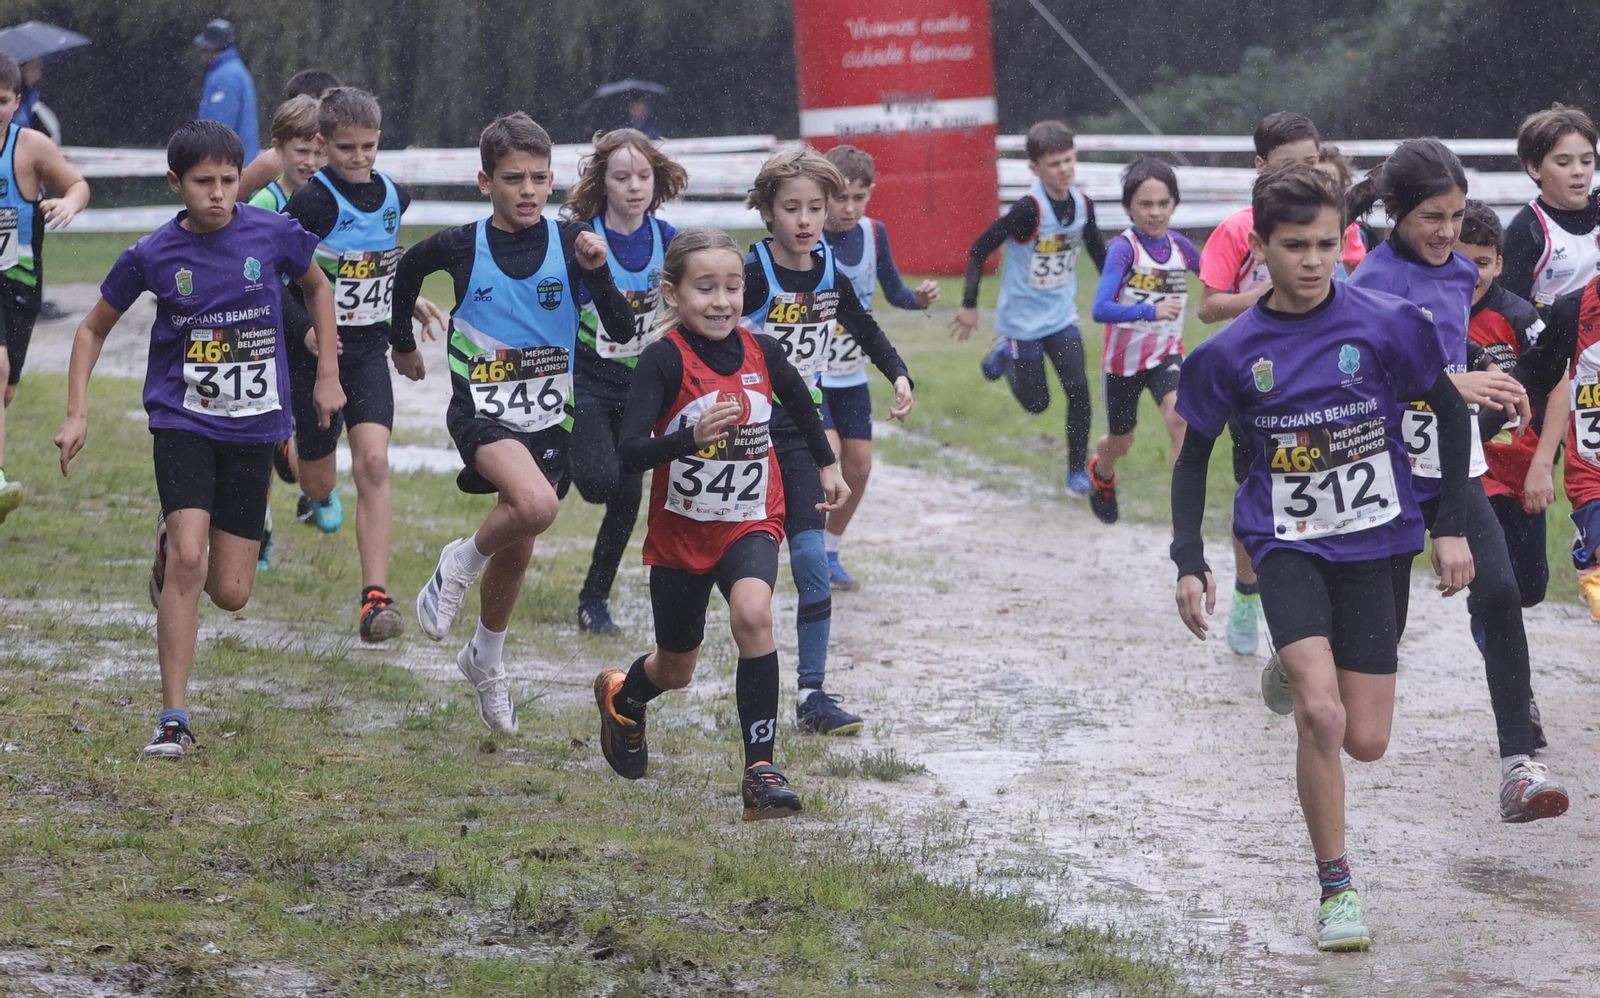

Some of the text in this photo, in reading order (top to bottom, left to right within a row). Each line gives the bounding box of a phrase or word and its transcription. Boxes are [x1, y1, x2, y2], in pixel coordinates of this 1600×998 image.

[187, 312, 224, 325] CHANS
[225, 305, 270, 322] BEMBRIVE
[237, 337, 276, 349] BELARMINO
[250, 346, 276, 357] ALONSO
[773, 323, 829, 360] 351
[521, 354, 568, 367] BELARMINO
[534, 362, 567, 374] ALONSO
[194, 362, 267, 401] 313
[475, 377, 563, 418] 346
[1255, 397, 1378, 429] CEIP CHANS BEMBRIVE
[745, 443, 768, 456] ALONSO
[1329, 426, 1386, 453] BELARMINO
[1347, 437, 1386, 459] ALONSO
[672, 456, 763, 502] 342
[1283, 461, 1382, 518] 312
